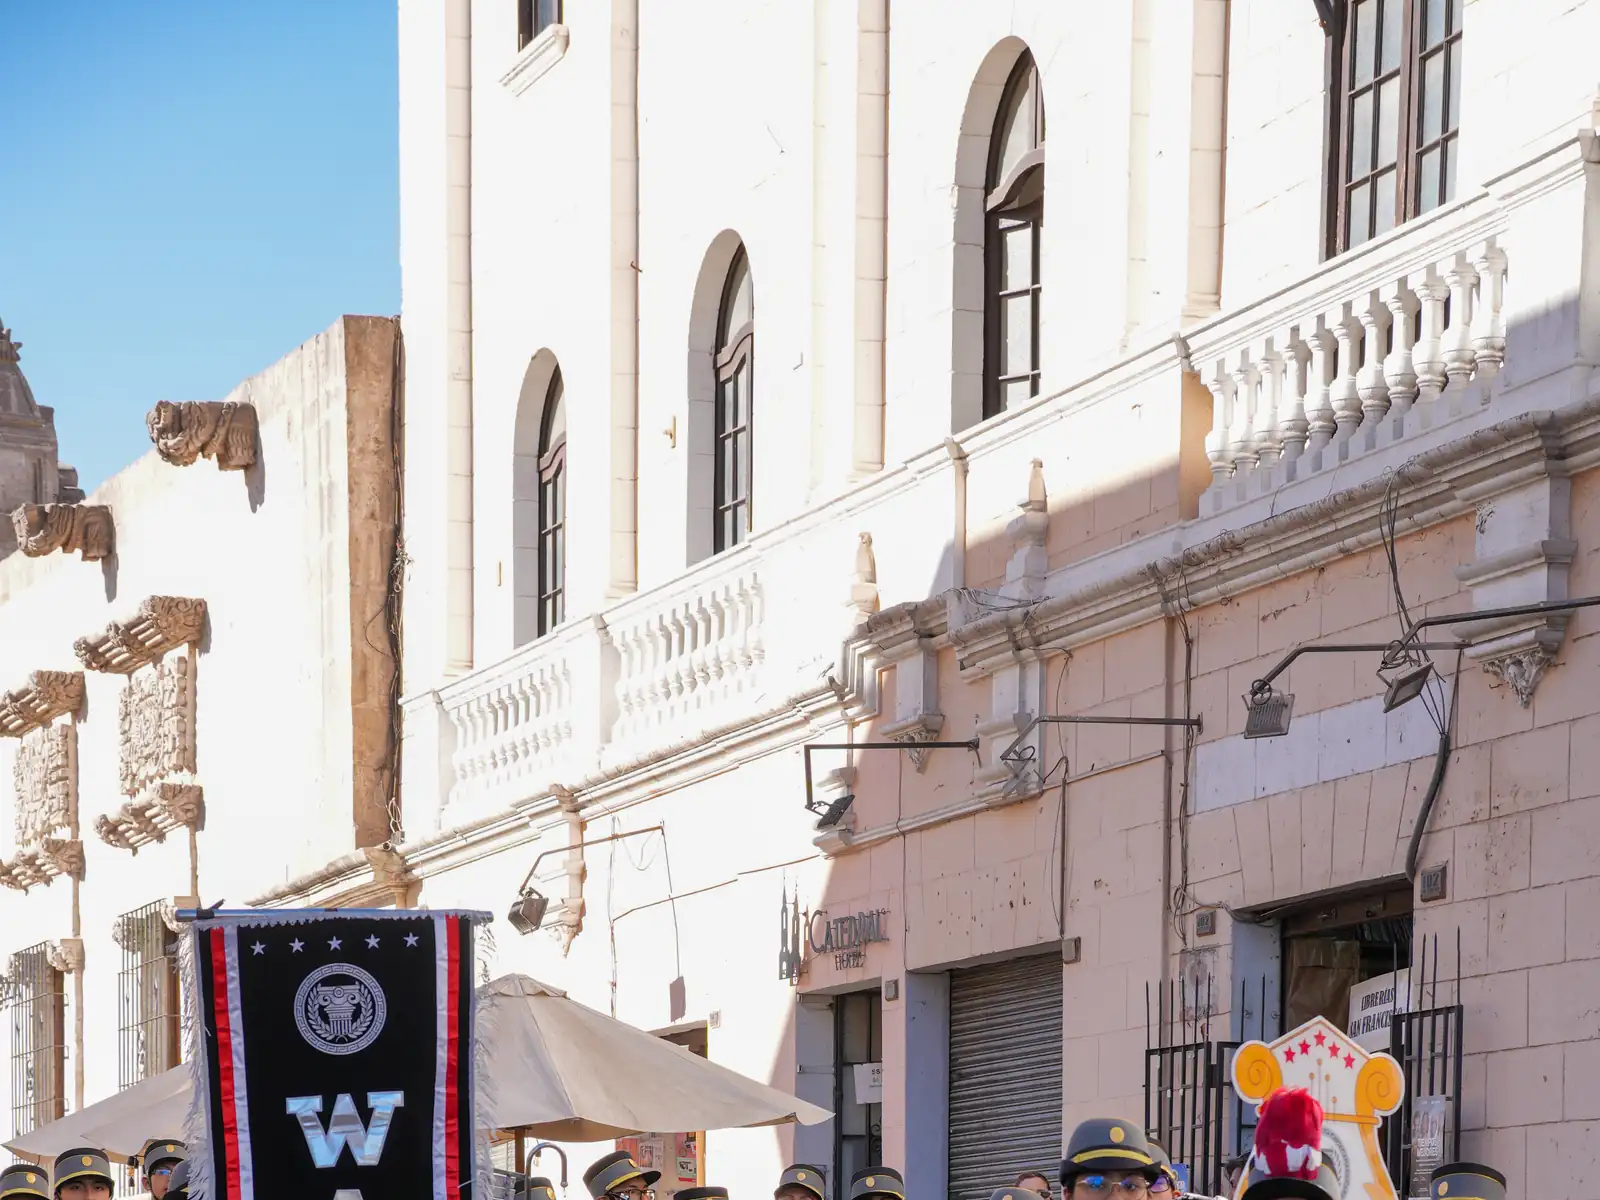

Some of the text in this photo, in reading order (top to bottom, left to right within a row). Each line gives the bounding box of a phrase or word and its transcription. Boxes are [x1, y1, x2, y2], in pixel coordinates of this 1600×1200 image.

[1423, 872, 1440, 889] 102
[810, 908, 884, 953] CATEDRAL
[1349, 1018, 1362, 1039] SAN
